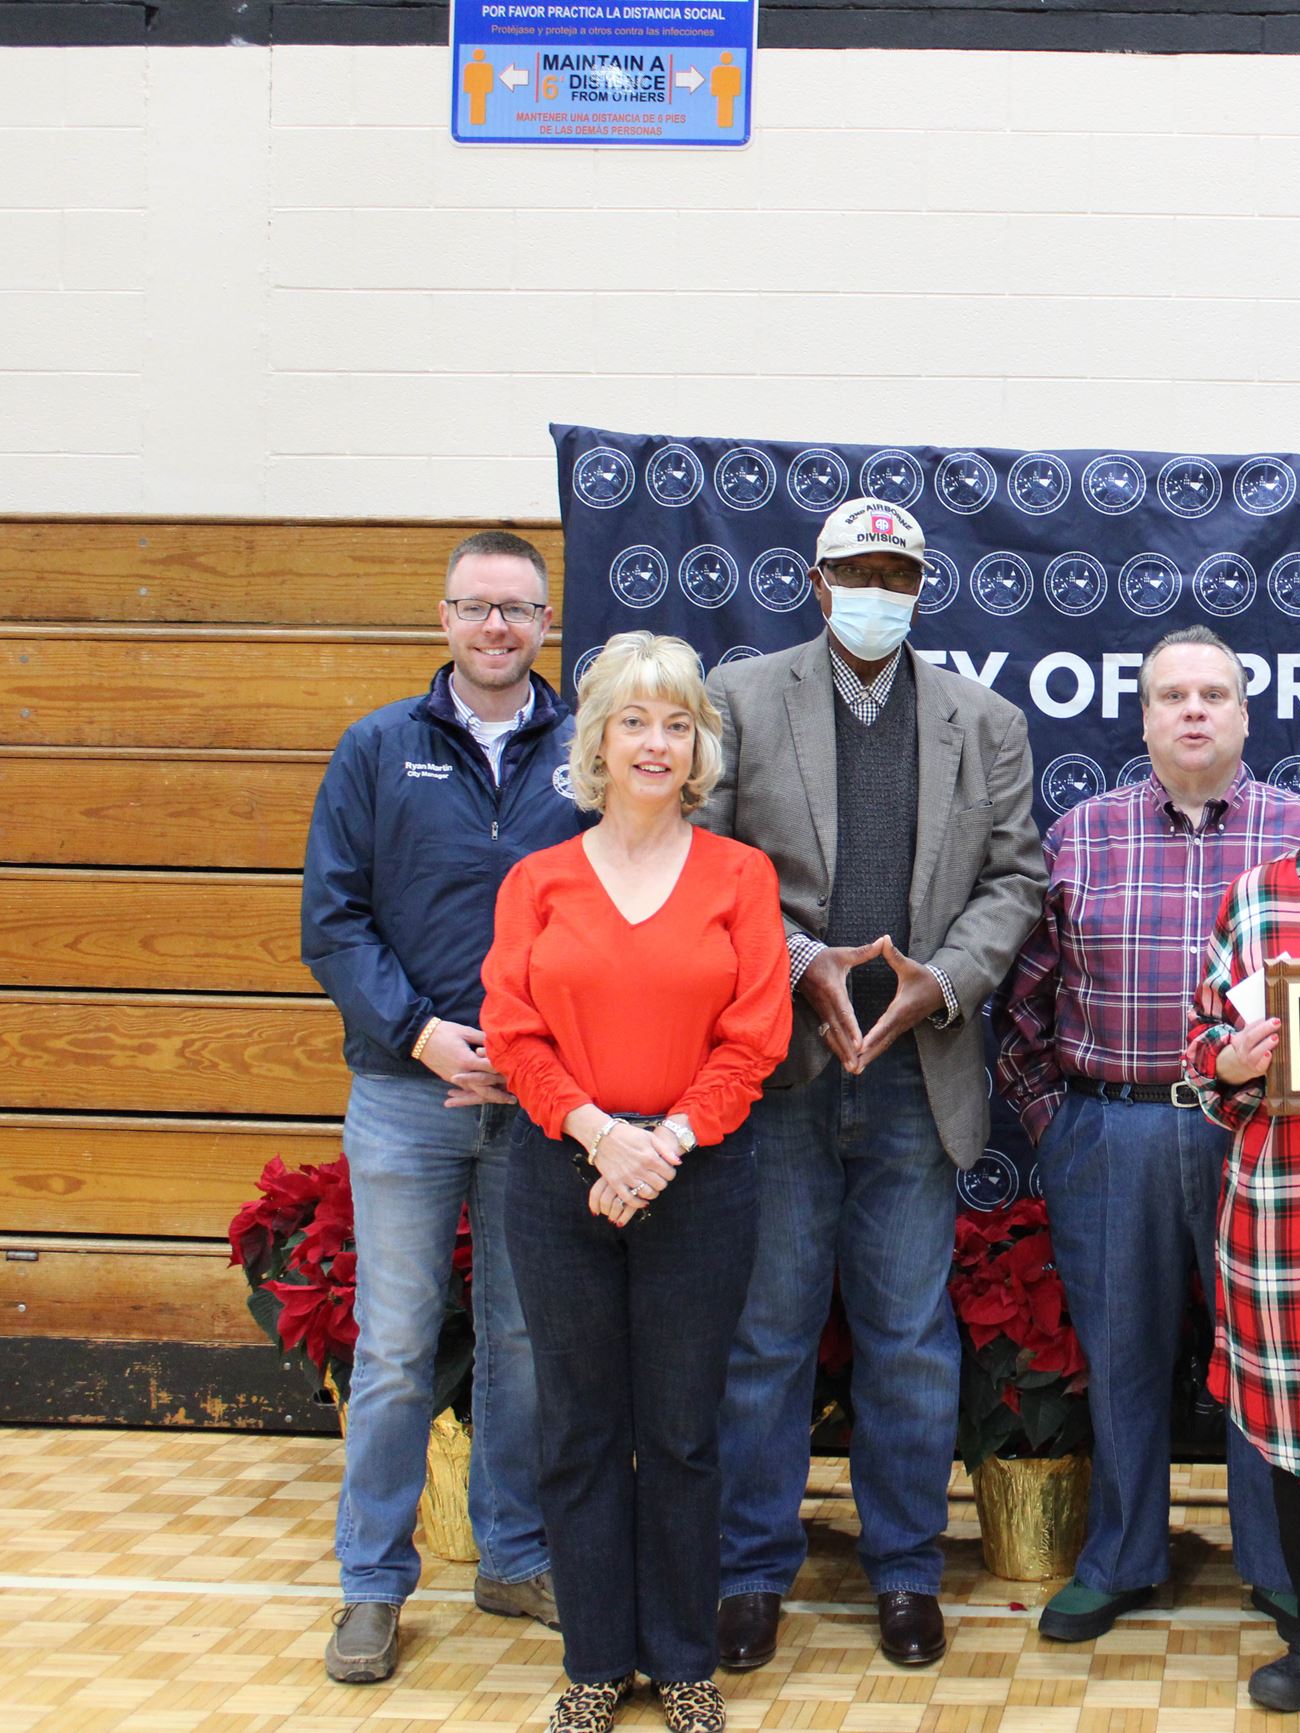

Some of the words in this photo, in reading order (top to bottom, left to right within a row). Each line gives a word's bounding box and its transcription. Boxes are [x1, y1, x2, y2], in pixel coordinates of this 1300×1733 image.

[482, 5, 506, 17] POR
[508, 5, 545, 18] FAVOR
[548, 6, 604, 18] PRACTICA
[606, 7, 621, 19] LA
[623, 7, 682, 19] DISTANCIA
[684, 8, 726, 20] SOCIAL
[537, 27, 543, 36] y
[545, 26, 578, 36] proteja
[580, 27, 586, 35] a
[588, 27, 612, 35] otros
[614, 27, 644, 36] contra
[646, 26, 660, 36] las
[662, 27, 715, 37] infecciones
[543, 54, 643, 72] MAINTAIN
[650, 55, 665, 72] A
[571, 91, 609, 101] FROM
[612, 92, 665, 102] OTHERS
[516, 112, 568, 122] MANTENER
[570, 112, 590, 122] UNA
[591, 113, 640, 122] DISTANCIA
[643, 113, 655, 123] DE
[665, 114, 687, 123] PIES
[539, 125, 553, 135] DE
[554, 125, 573, 135] LAS
[611, 126, 662, 136] PERSONAS
[866, 503, 913, 530] AIRBORNE
[857, 533, 906, 548] DIVISION
[1029, 651, 1143, 719] OF
[405, 761, 427, 770] Ryan
[427, 763, 453, 771] Martin
[407, 770, 420, 778] City
[421, 771, 449, 780] Manager
